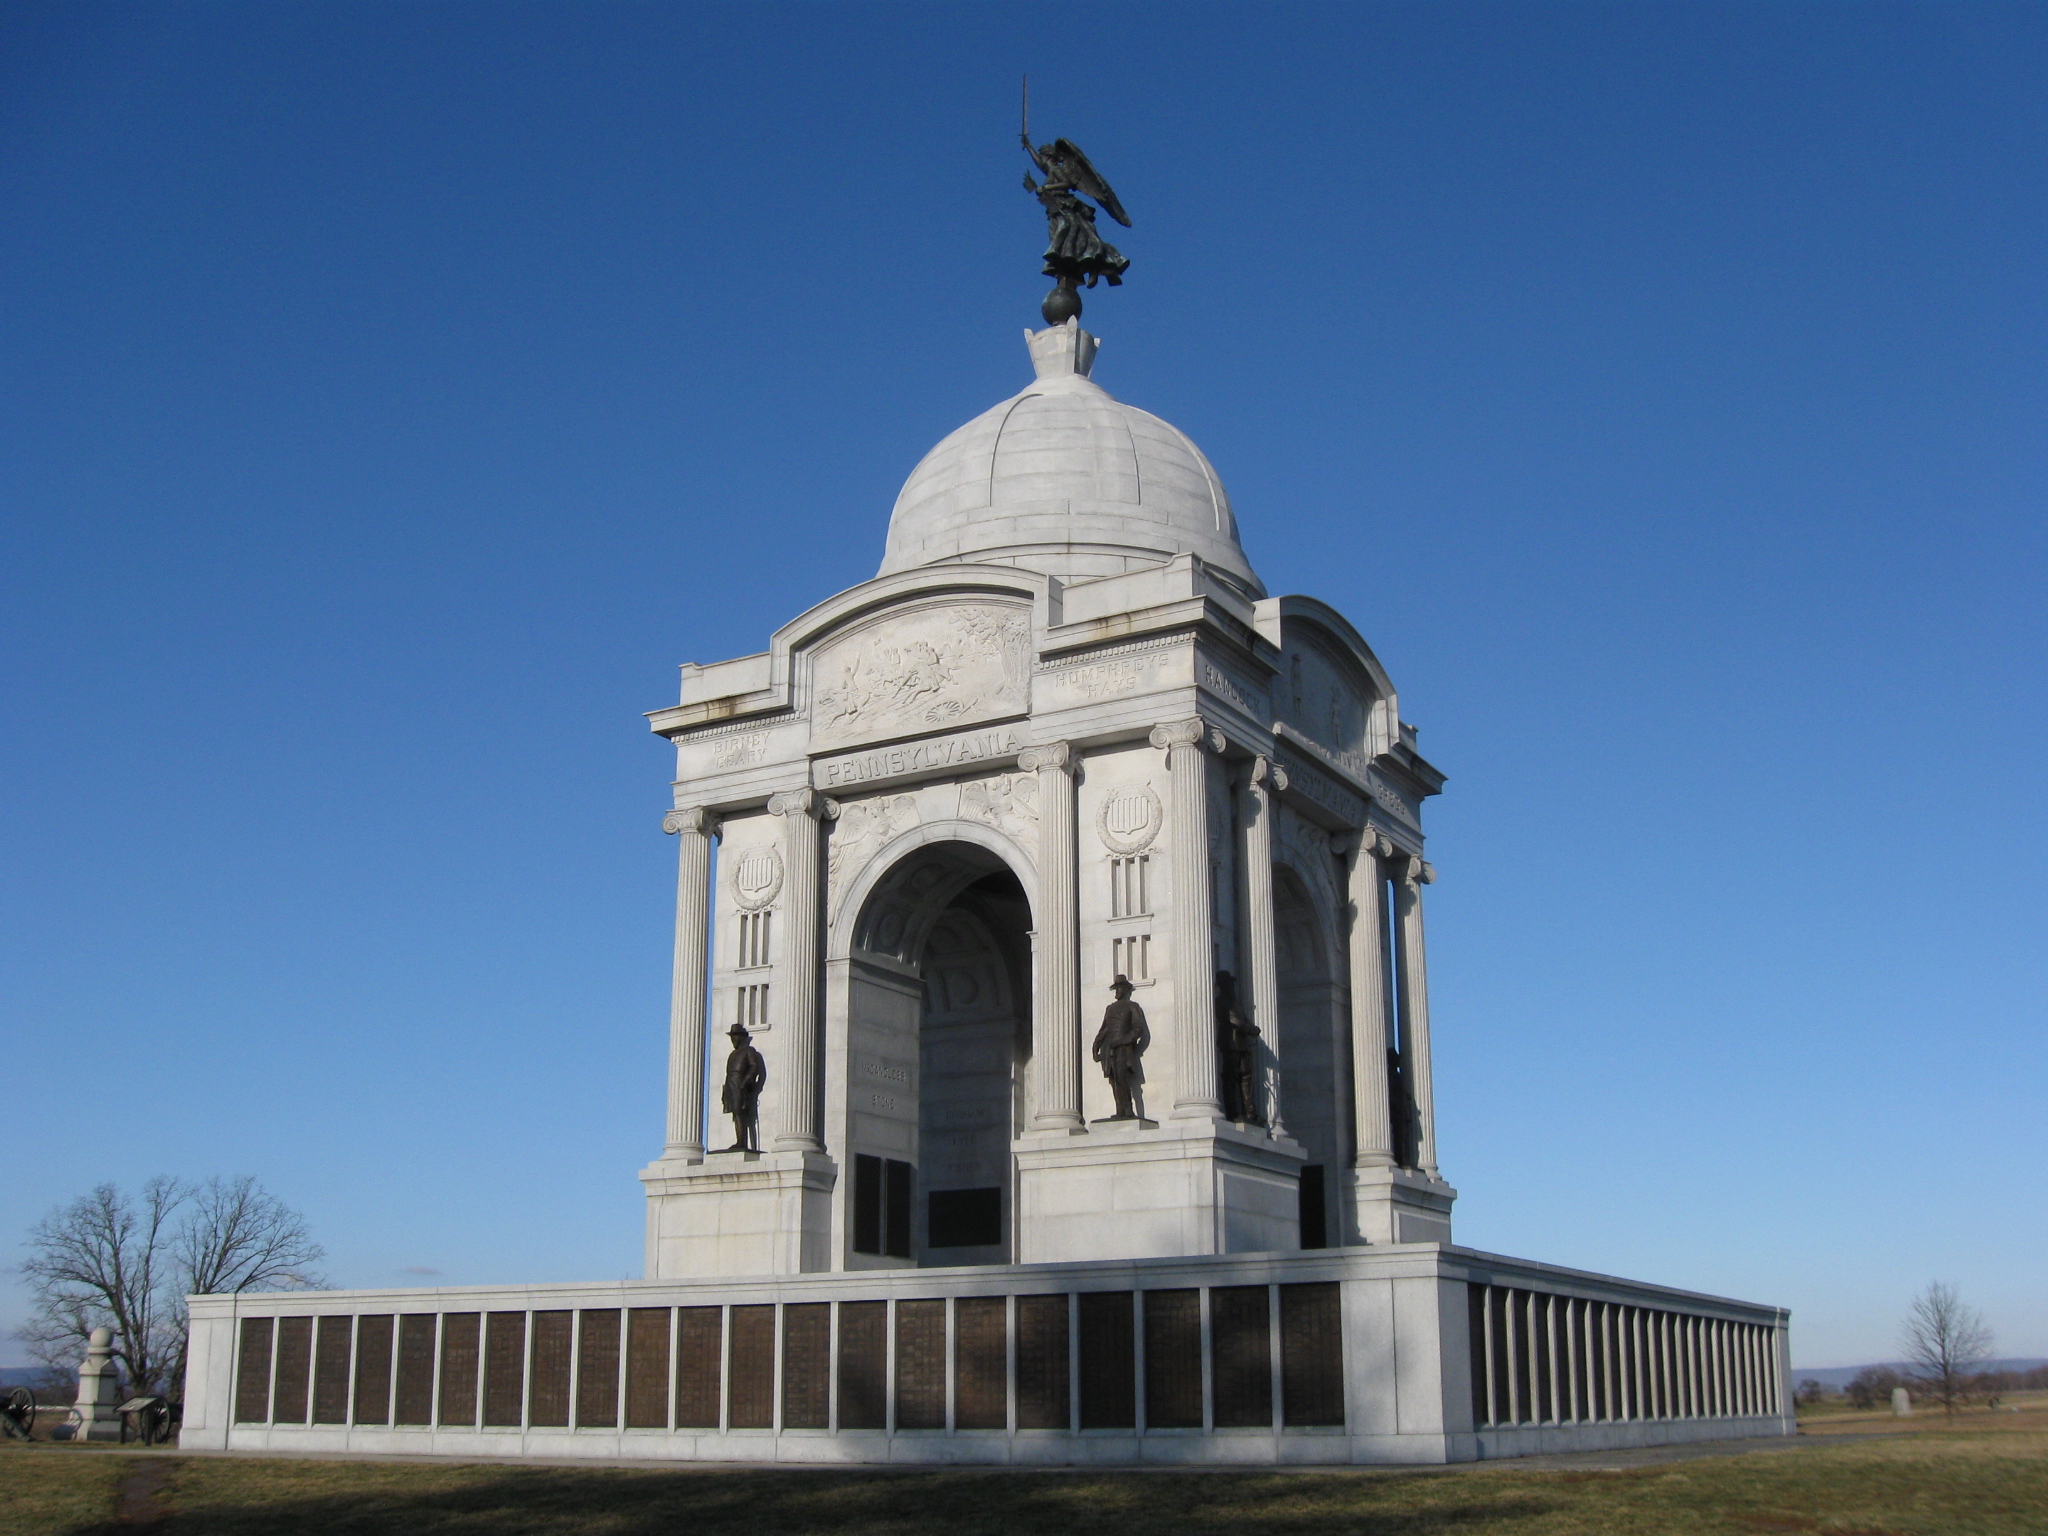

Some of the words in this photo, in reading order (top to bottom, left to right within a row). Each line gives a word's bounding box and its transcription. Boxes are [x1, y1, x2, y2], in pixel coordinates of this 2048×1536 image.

[1055, 653, 1169, 687] HUMPHREYS
[1088, 677, 1136, 699] HAYS
[1205, 664, 1261, 715] HANCOCK
[713, 731, 771, 754] BIRNEY
[716, 748, 767, 769] GEARY
[824, 729, 1024, 785] PENNSYLVANIA
